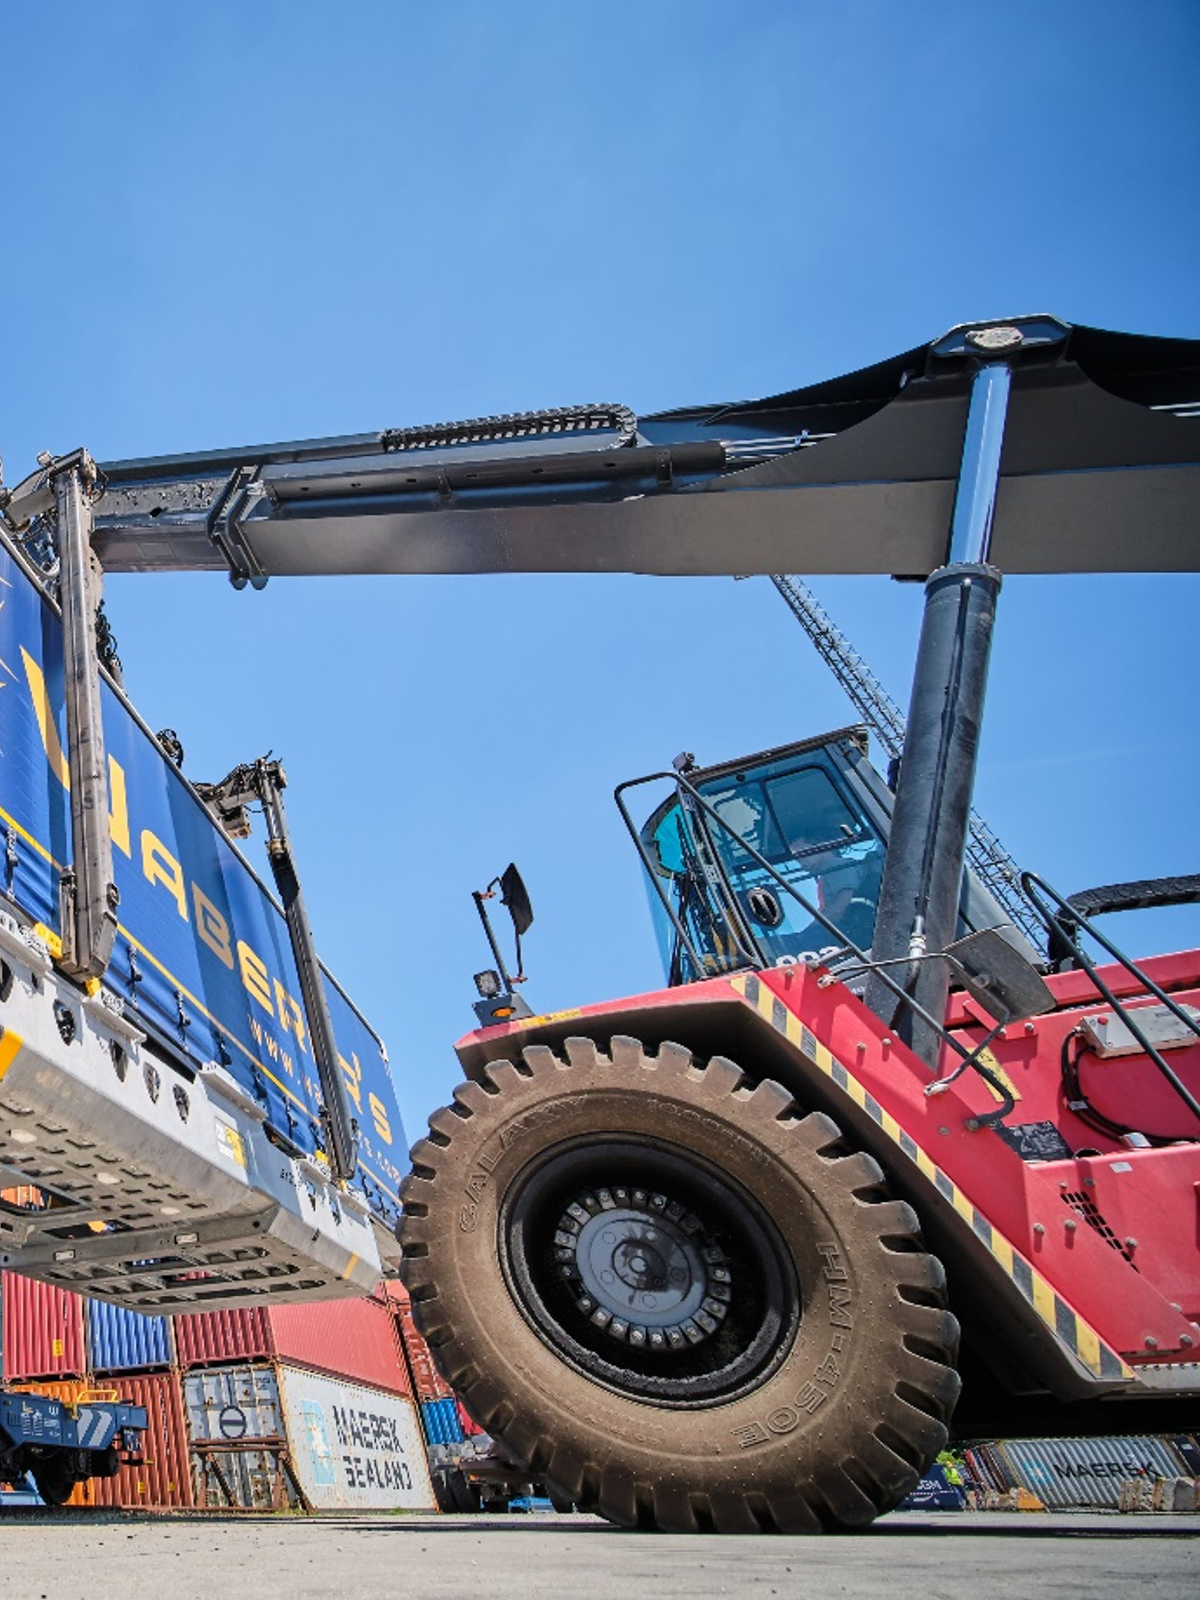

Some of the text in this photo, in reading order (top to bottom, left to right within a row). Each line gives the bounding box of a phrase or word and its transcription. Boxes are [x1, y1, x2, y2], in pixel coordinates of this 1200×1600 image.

[331, 1405, 405, 1453] MAERSK
[342, 1455, 413, 1490] SEALAND
[1052, 1461, 1163, 1479] MAERSK
